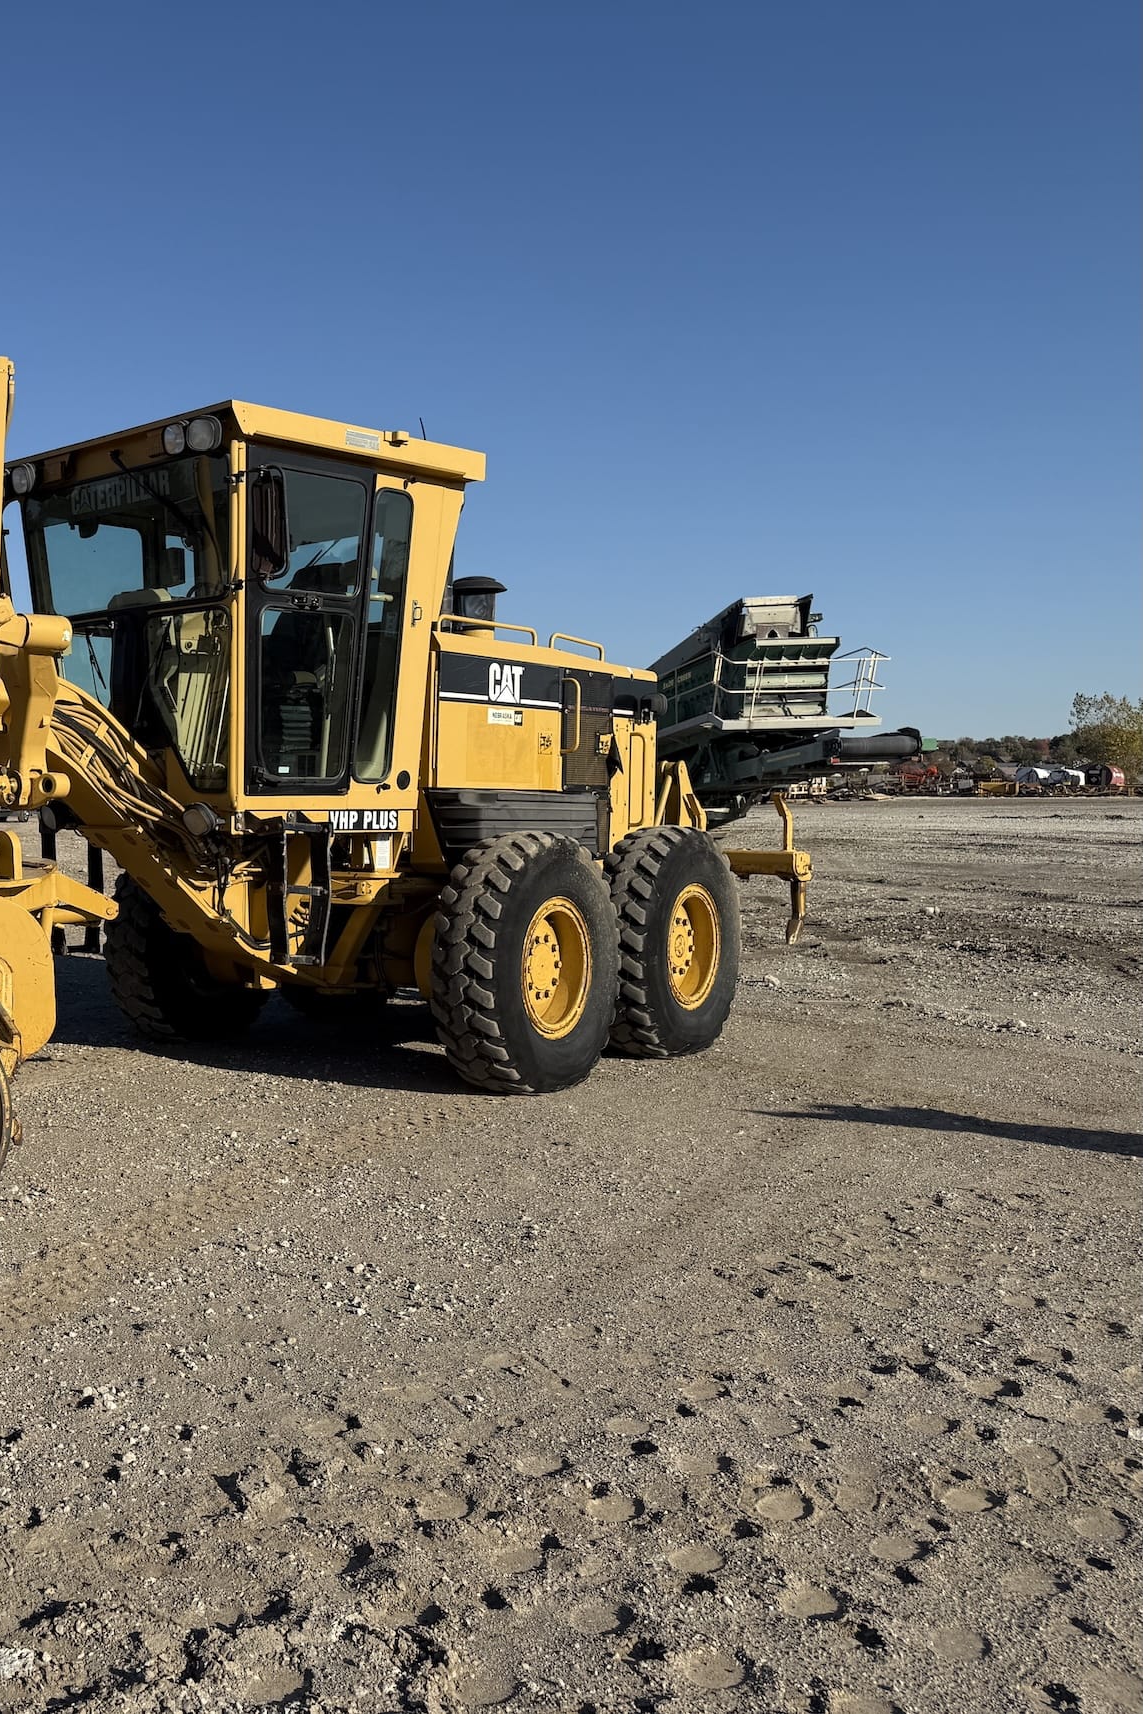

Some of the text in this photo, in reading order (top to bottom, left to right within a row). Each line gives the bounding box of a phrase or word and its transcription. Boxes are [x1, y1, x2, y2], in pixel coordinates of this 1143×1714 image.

[71, 469, 170, 515] CATERPILLAR
[488, 662, 524, 704] CAT
[330, 810, 397, 830] VHP PLUS
